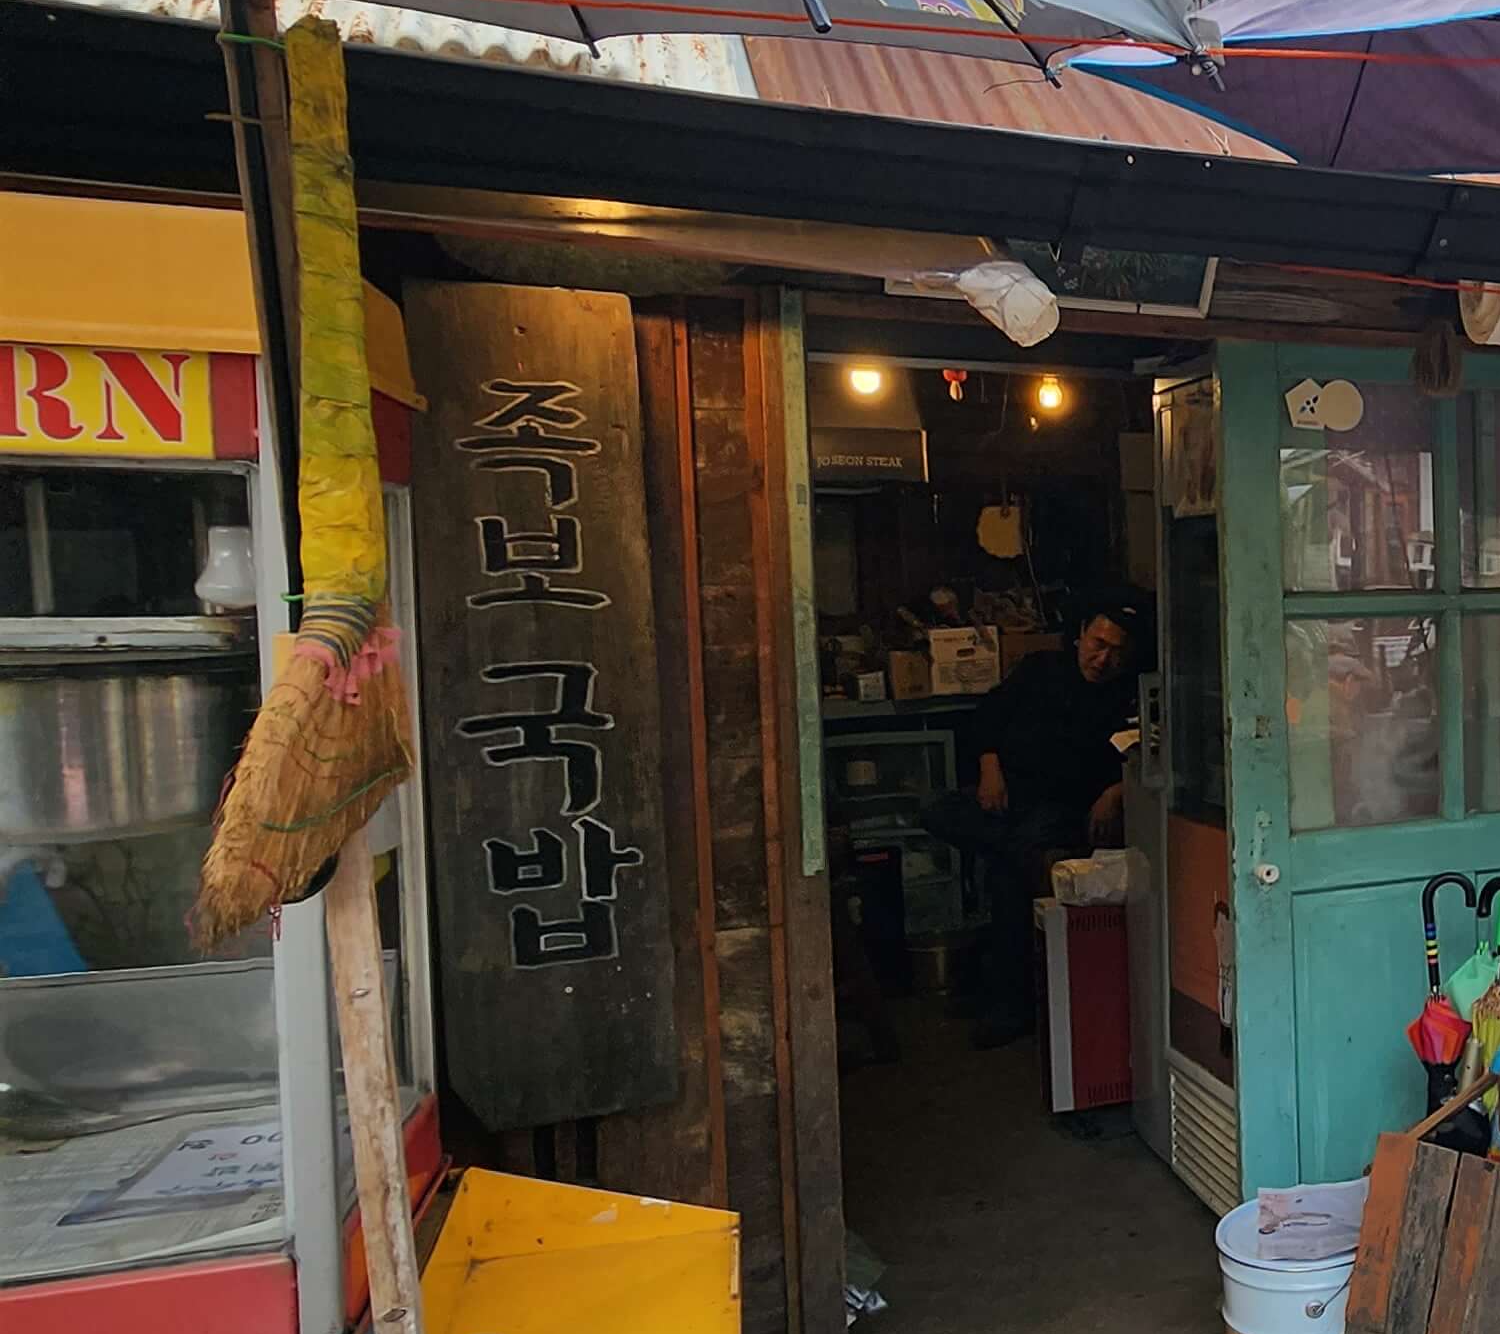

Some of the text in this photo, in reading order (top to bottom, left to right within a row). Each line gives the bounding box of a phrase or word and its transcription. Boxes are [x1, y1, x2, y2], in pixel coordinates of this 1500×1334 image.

[866, 455, 904, 468] STEAK
[455, 377, 645, 970] 족보 국밥
